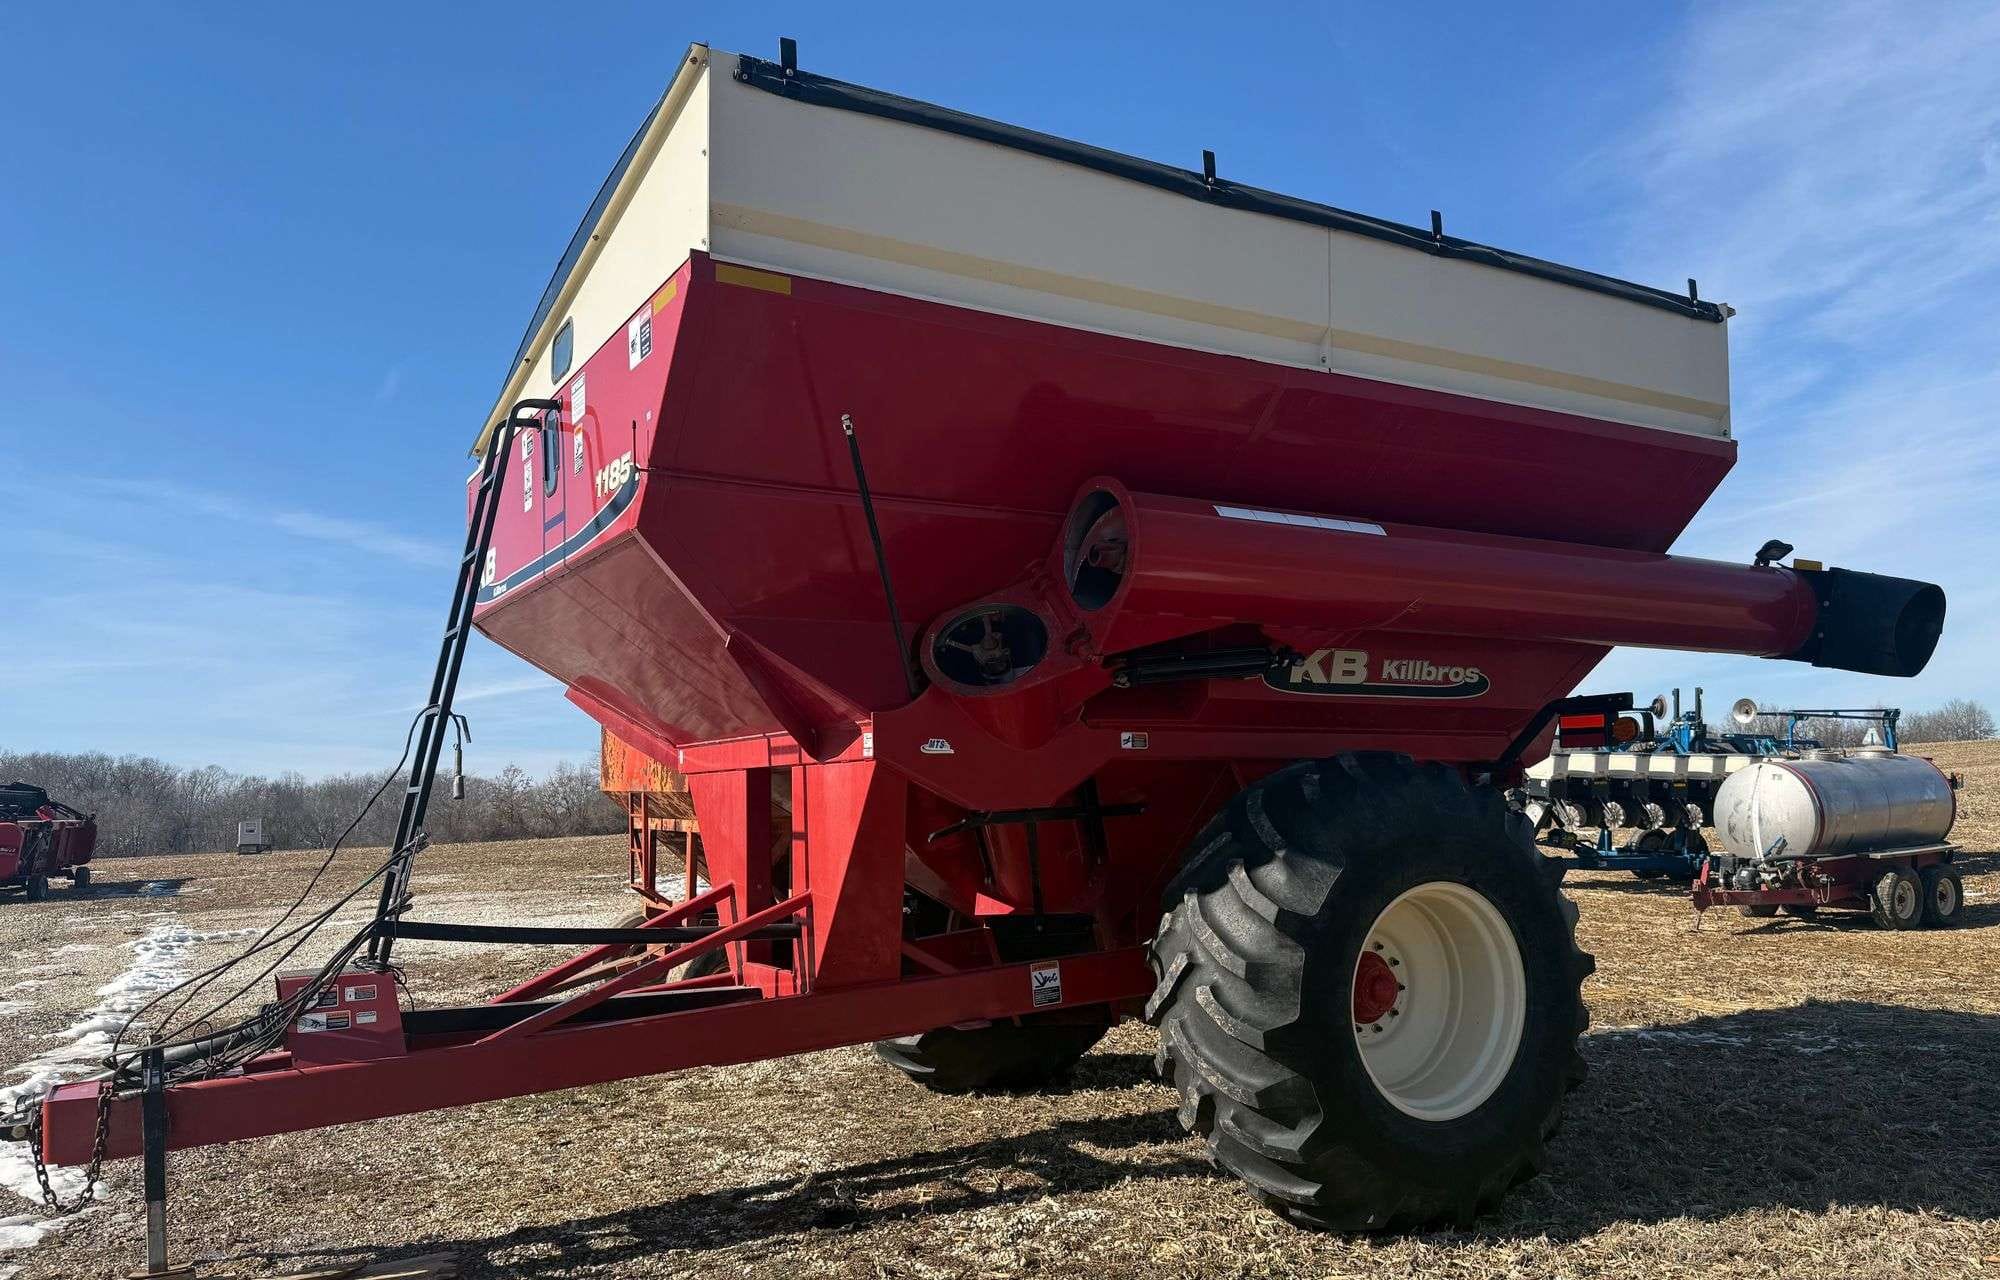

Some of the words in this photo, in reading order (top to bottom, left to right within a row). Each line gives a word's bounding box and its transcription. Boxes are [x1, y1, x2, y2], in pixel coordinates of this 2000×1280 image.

[595, 450, 632, 498] 1185
[1290, 648, 1369, 684] KB
[1382, 659, 1482, 683] Killbros
